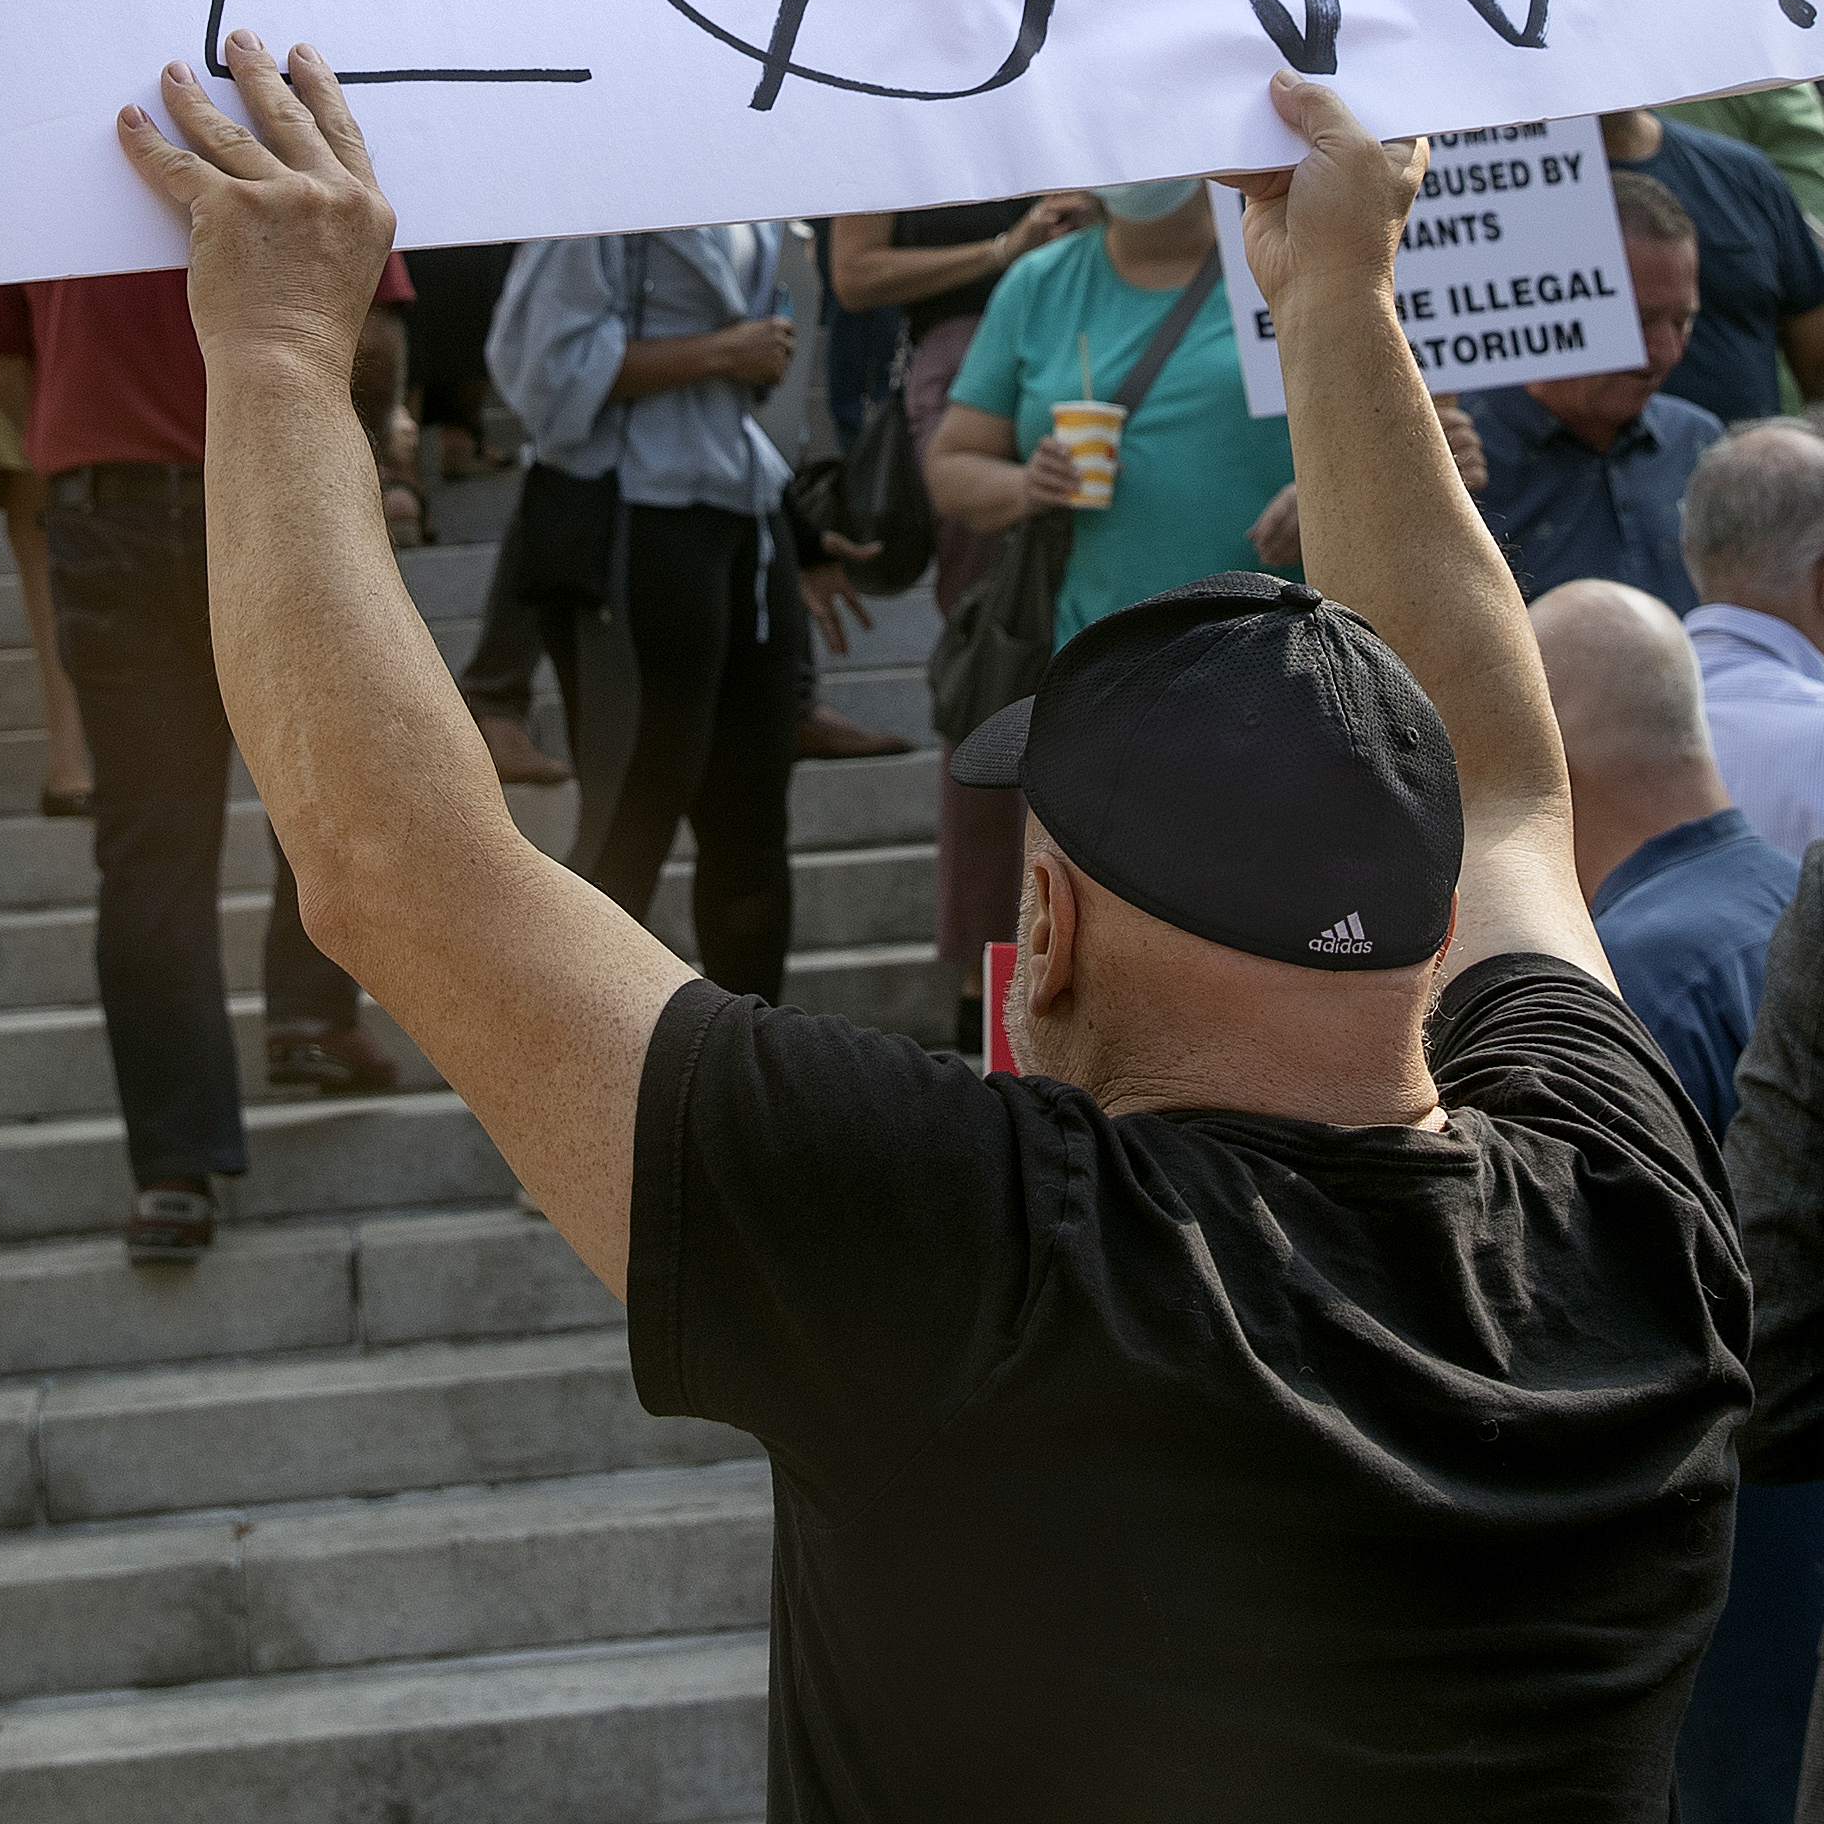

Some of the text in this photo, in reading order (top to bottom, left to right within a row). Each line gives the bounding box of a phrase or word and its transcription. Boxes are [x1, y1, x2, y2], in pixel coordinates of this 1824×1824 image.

[1416, 153, 1581, 199] BUSED BY
[1399, 212, 1502, 250] ANTS
[1394, 268, 1616, 323] HE ILLEGAL
[1408, 321, 1585, 369] ATORIUM
[1308, 937, 1373, 954] adidas
